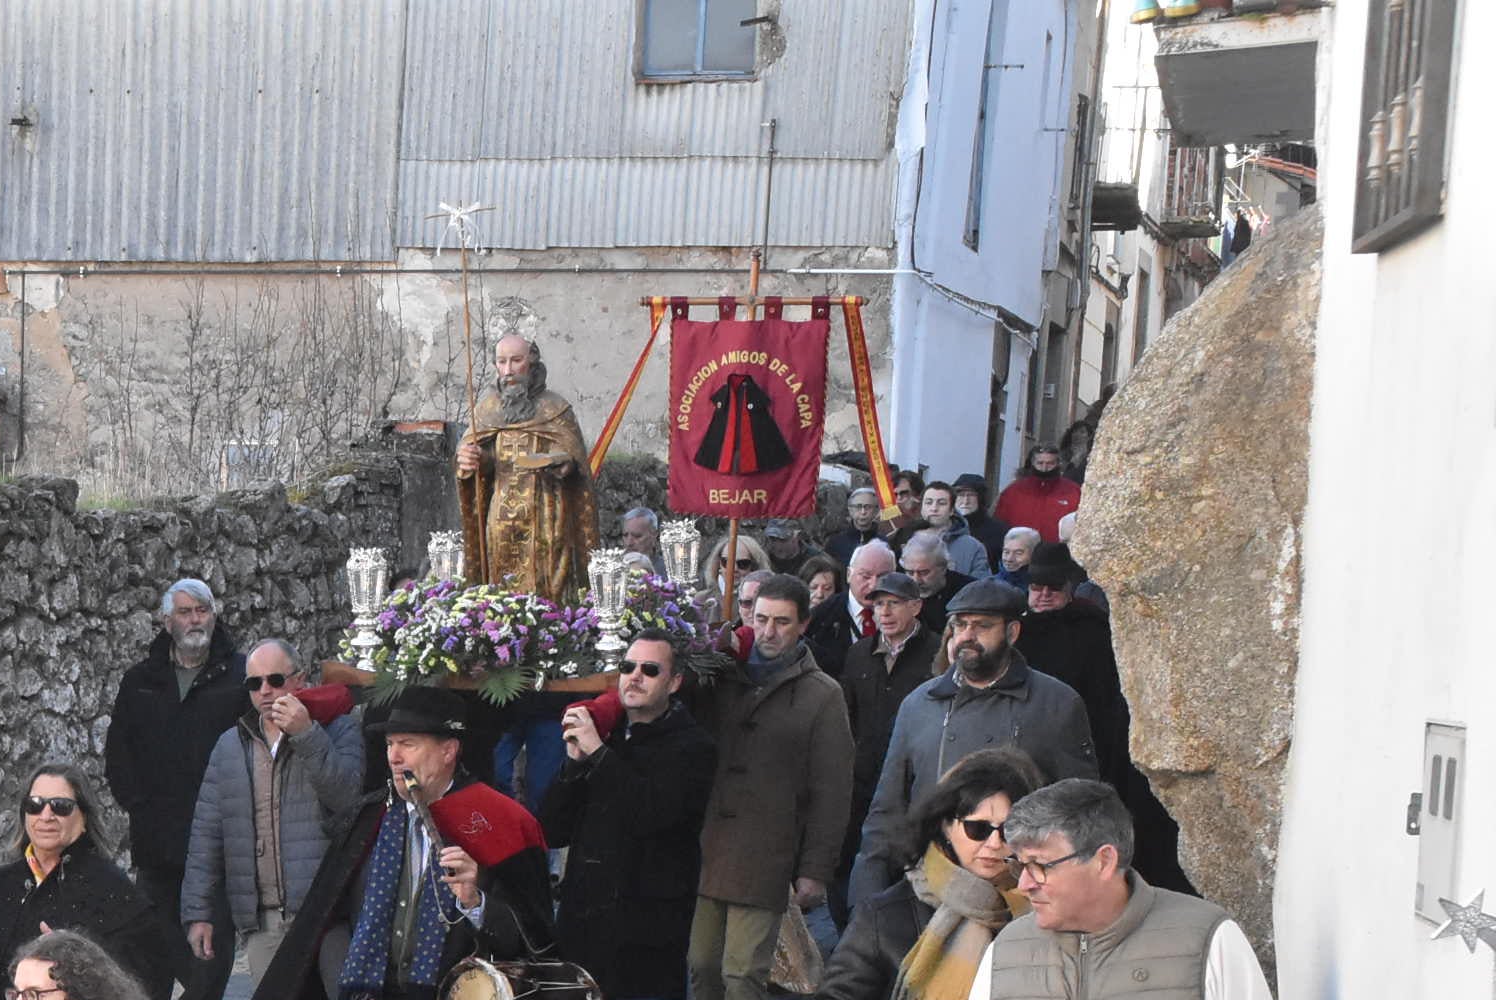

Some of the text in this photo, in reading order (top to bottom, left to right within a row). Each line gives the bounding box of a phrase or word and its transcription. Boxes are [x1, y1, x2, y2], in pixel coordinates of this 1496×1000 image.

[678, 350, 812, 431] ASOCIACION AMIGOS DE LA CAPA
[709, 489, 767, 504] BEJAR
